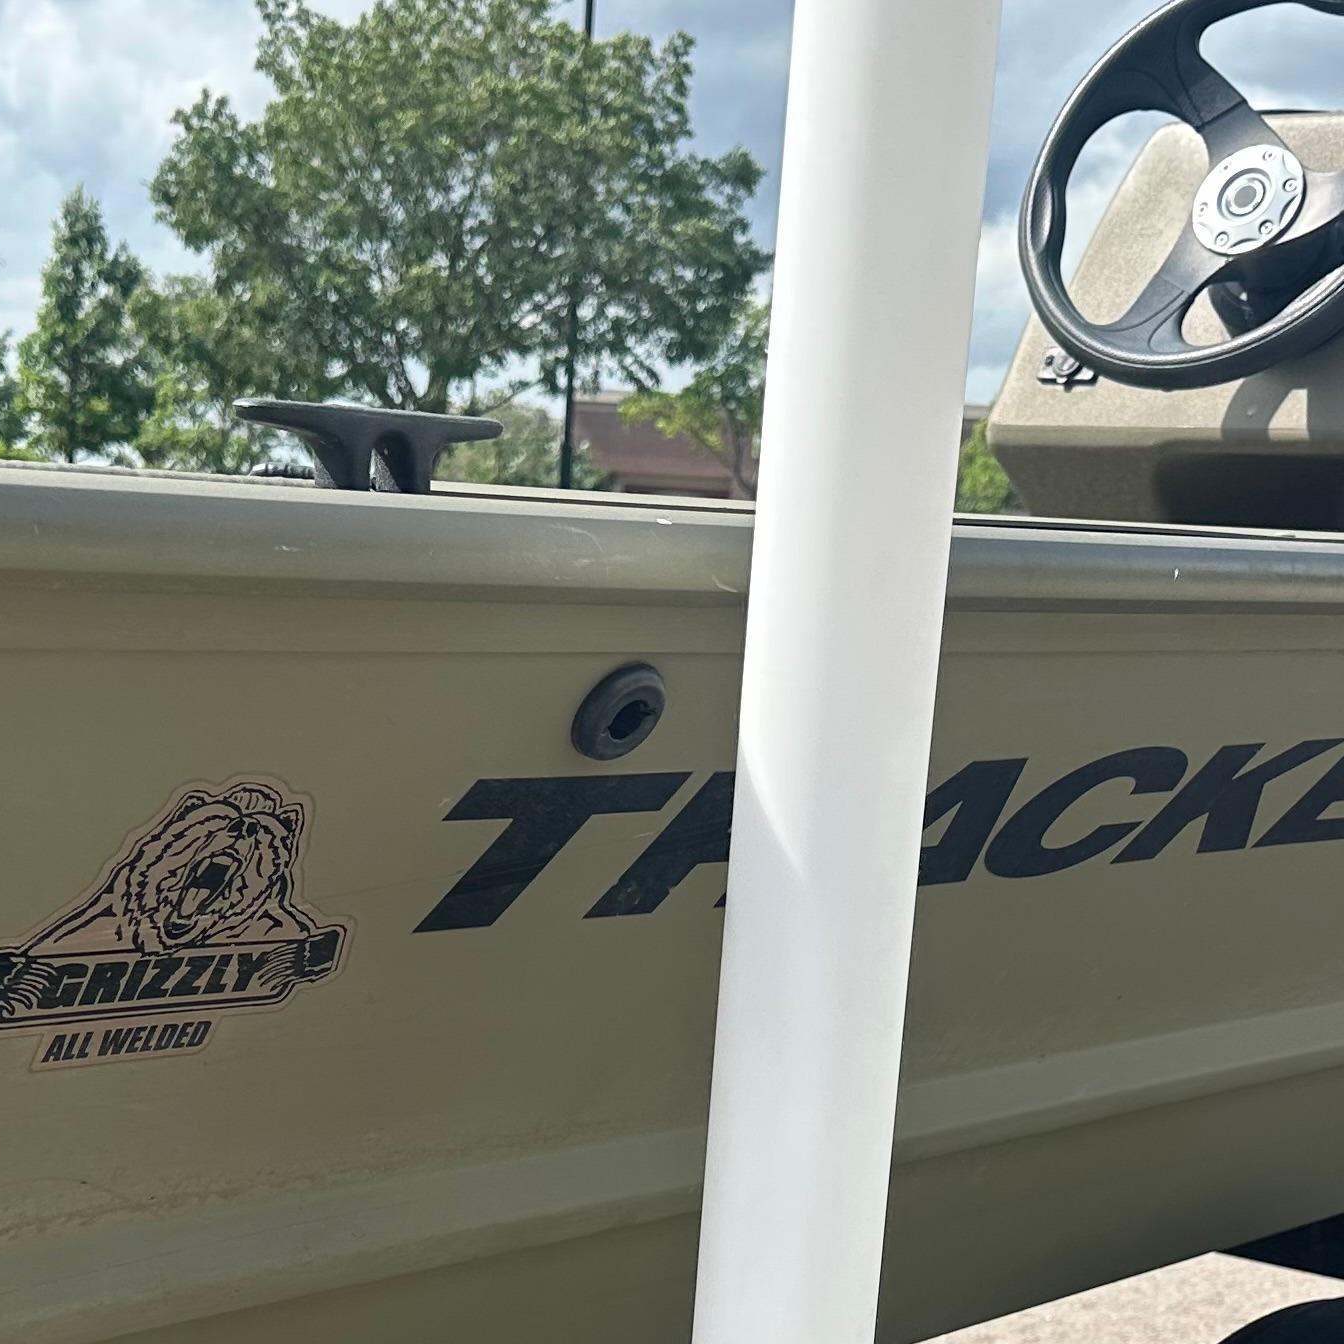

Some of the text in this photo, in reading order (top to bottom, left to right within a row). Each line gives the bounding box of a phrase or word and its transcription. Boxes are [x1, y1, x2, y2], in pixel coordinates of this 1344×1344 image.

[36, 951, 272, 1010] GRIZZLY
[40, 1020, 213, 1064] ALL WELDED
